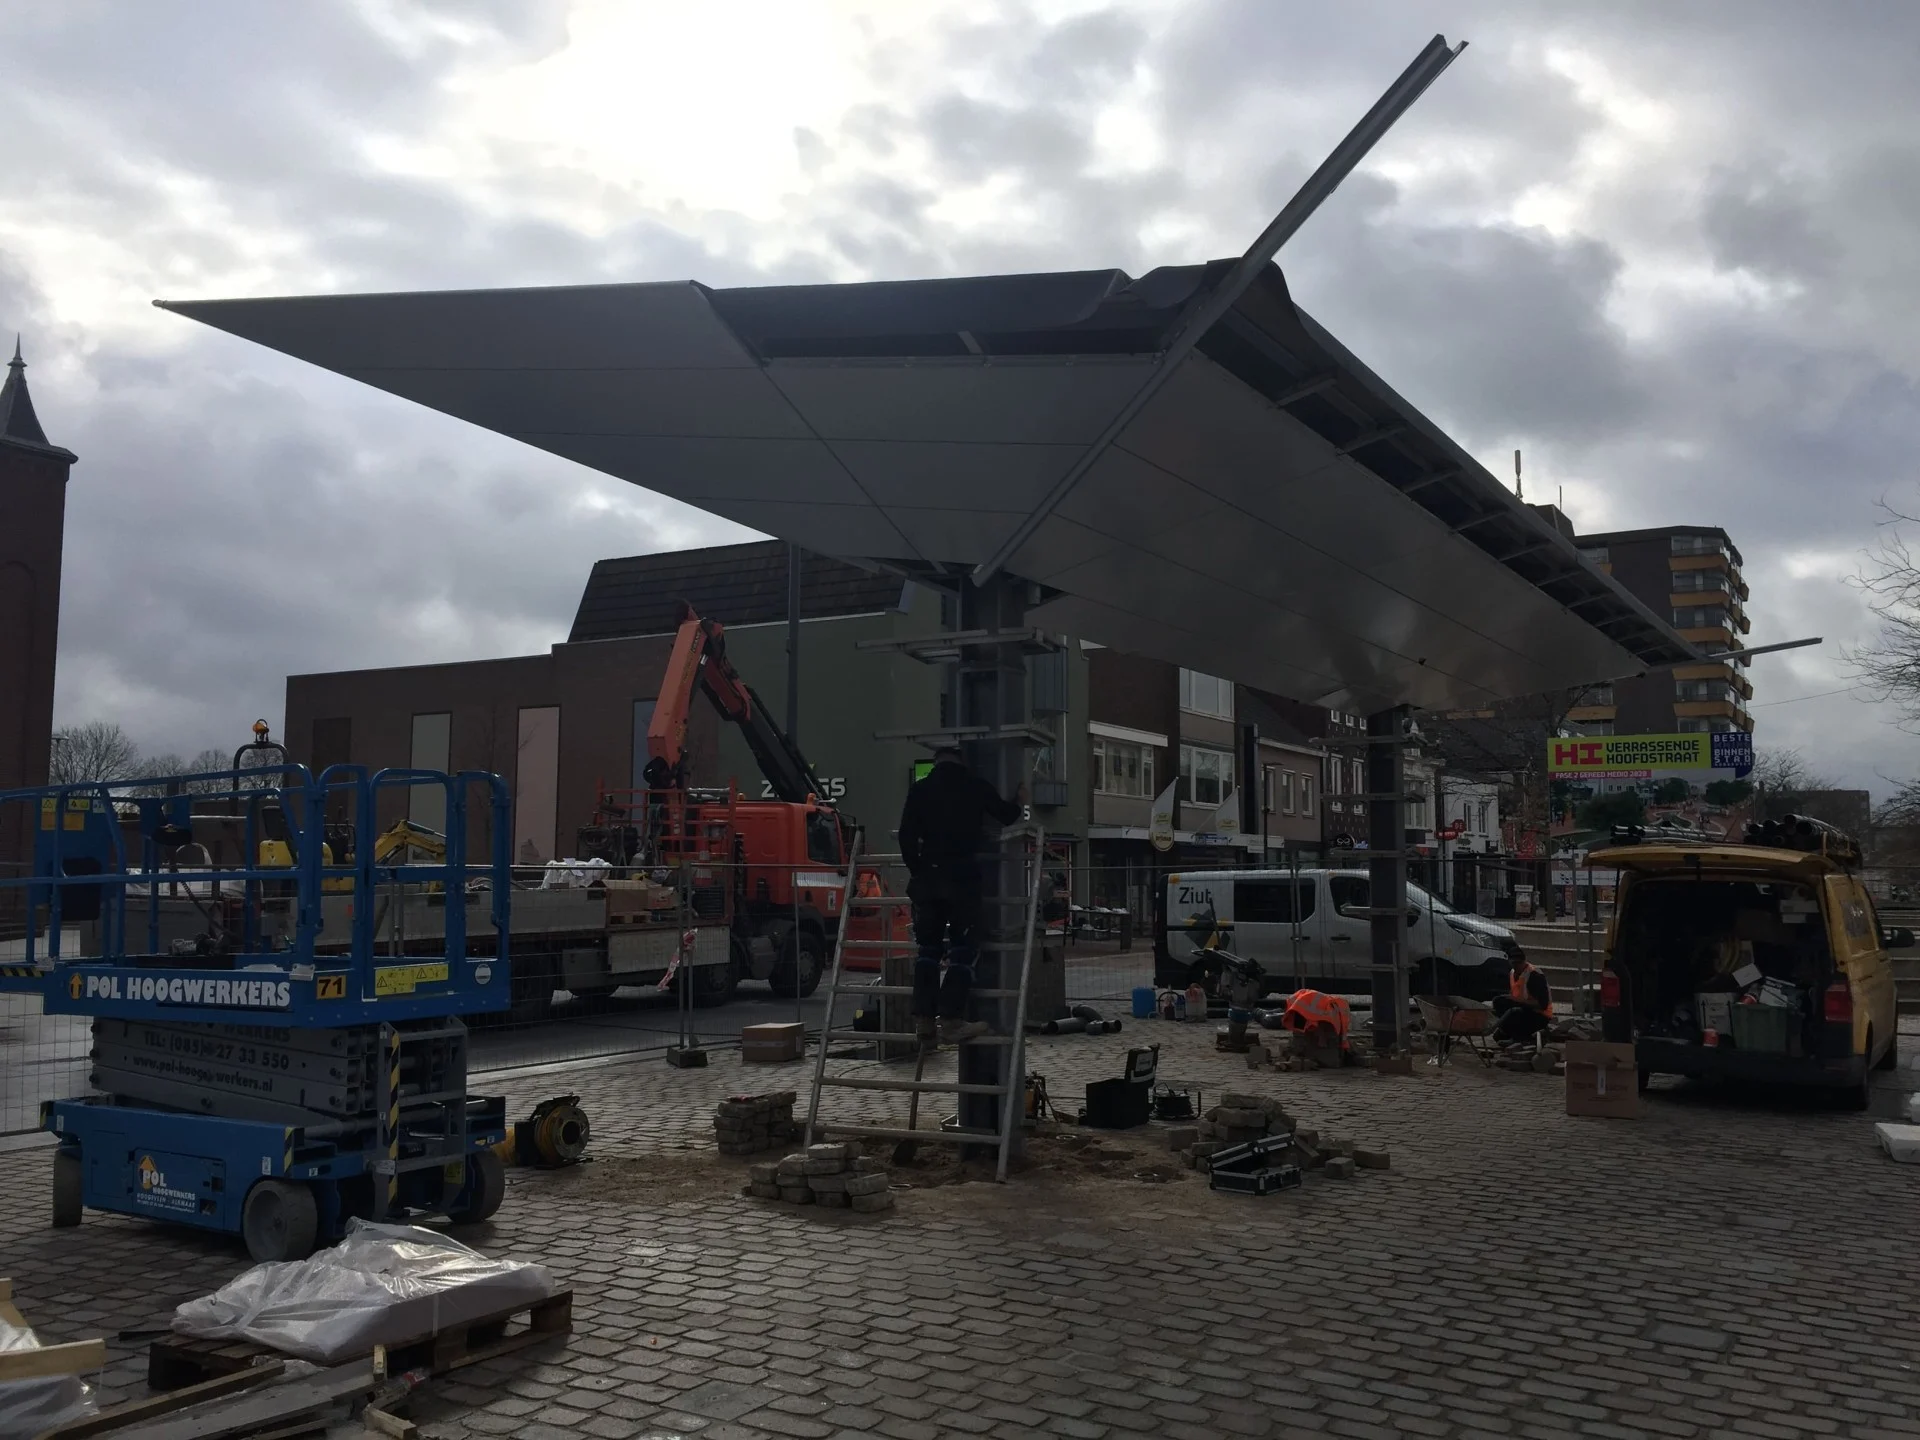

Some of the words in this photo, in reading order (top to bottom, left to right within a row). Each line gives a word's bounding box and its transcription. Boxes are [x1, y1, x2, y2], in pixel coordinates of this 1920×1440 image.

[1713, 733, 1751, 742] BESTE
[1555, 743, 1603, 765] HI
[1606, 740, 1700, 753] VERRASSENDE
[1606, 751, 1700, 765] HOOFDSTRAAT
[1713, 747, 1751, 756] BINNEN
[1179, 886, 1211, 904] Ziut
[86, 974, 121, 1000] POL
[127, 976, 291, 1007] HOOGWERKERS
[318, 977, 343, 997] 71
[216, 1044, 234, 1060] 27
[238, 1046, 256, 1065] 33
[261, 1051, 290, 1070] 550
[143, 1169, 167, 1188] POL
